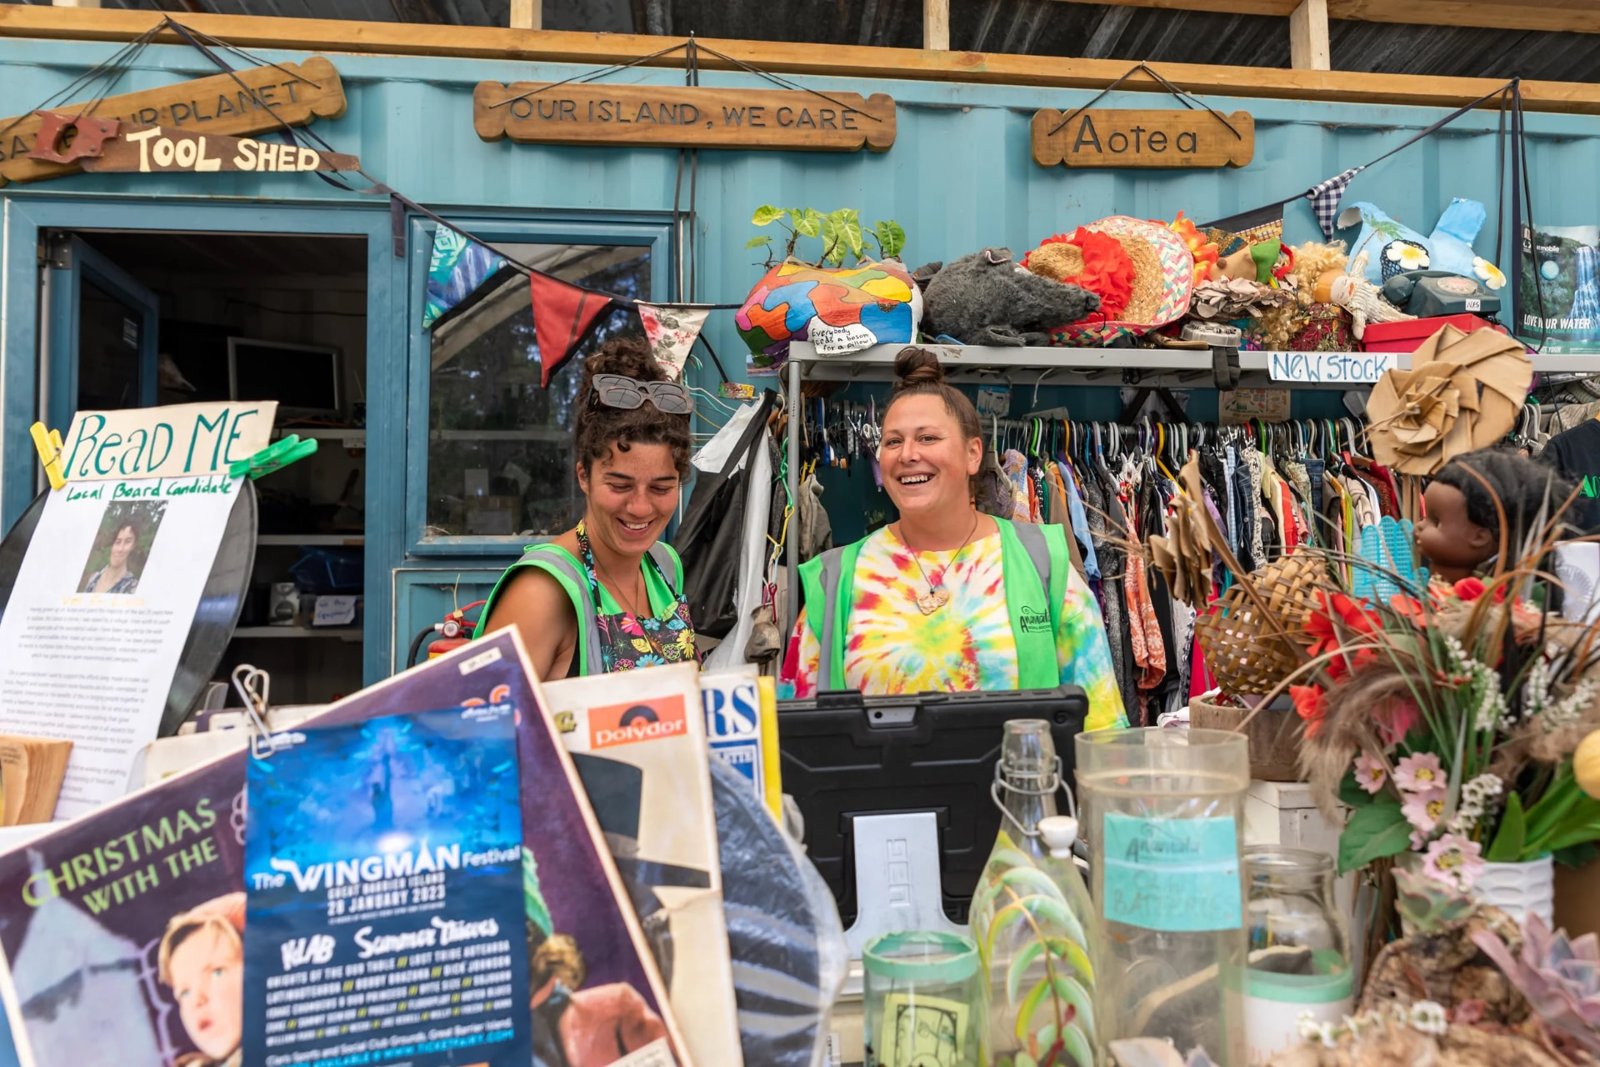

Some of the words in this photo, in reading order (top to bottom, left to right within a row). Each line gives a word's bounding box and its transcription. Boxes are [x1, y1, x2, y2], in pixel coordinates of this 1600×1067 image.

[170, 79, 300, 126] PLANET
[509, 99, 577, 122] OUR
[588, 100, 714, 129] ISLAND,
[722, 105, 766, 127] WE
[775, 106, 859, 130] CARE
[126, 126, 222, 172] TOOL
[233, 138, 320, 172] SHED
[1071, 113, 1198, 155] Aotea
[811, 326, 851, 337] Everybody
[1523, 313, 1537, 327] LOVE
[1560, 318, 1590, 329] WATER
[183, 408, 259, 473] ME
[66, 484, 105, 502] Local
[112, 478, 163, 500] Board
[165, 475, 233, 496] Candidate
[595, 718, 684, 745] Polydor
[22, 798, 216, 907] CHRISTMAS
[252, 873, 287, 890] The
[270, 839, 460, 892] WINGMAN
[461, 845, 521, 868] Festival
[82, 864, 160, 915] WITH
[163, 836, 219, 879] THE
[349, 889, 410, 914] JANUARY
[412, 884, 446, 904] 2023
